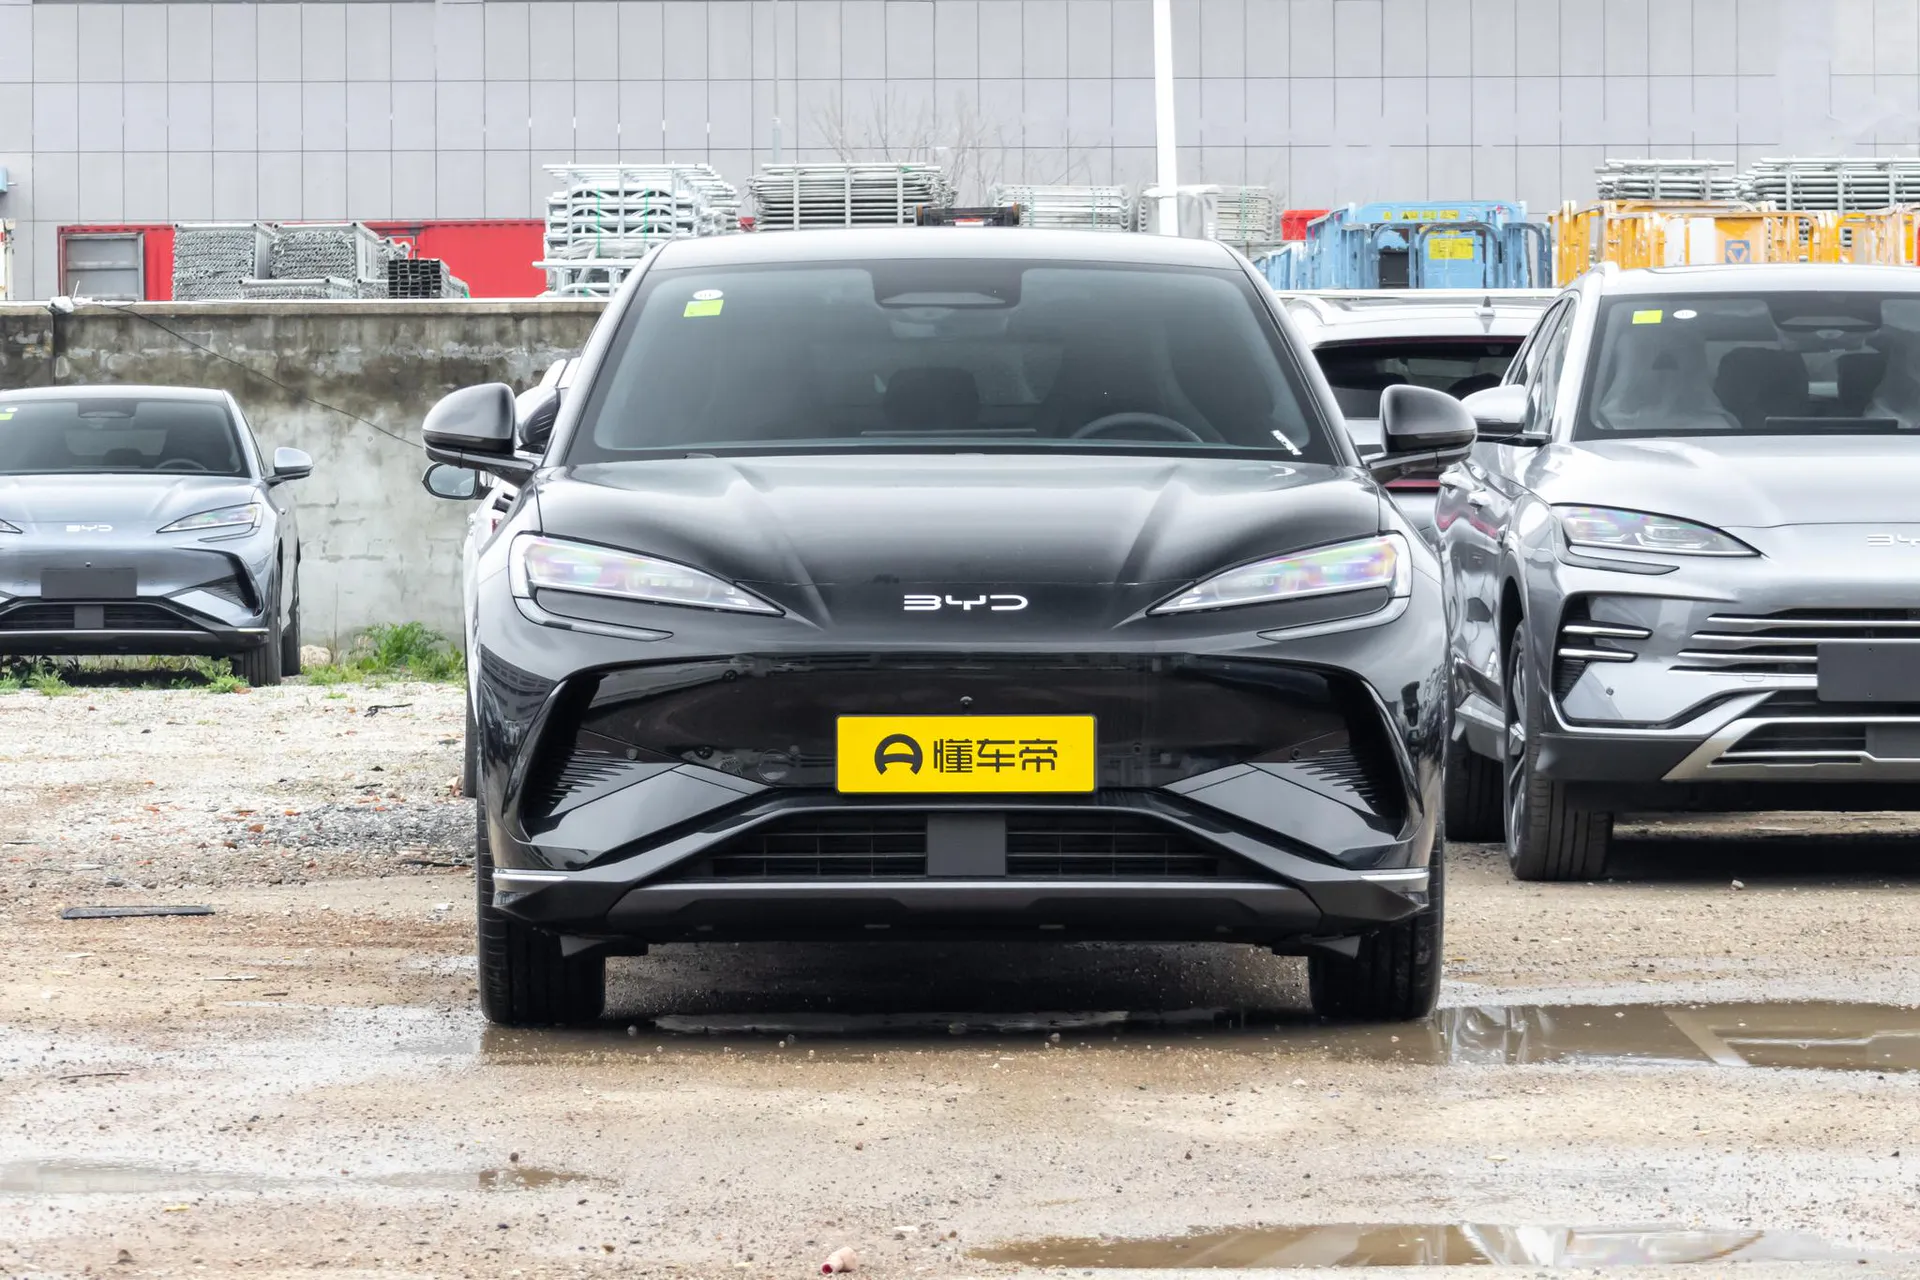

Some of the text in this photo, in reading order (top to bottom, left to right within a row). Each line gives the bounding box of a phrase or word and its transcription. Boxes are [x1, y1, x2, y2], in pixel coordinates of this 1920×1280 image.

[66, 524, 113, 532] BYD
[1866, 533, 1920, 547] BY
[903, 594, 1029, 611] BYD
[933, 738, 1058, 773] 懂车帝
